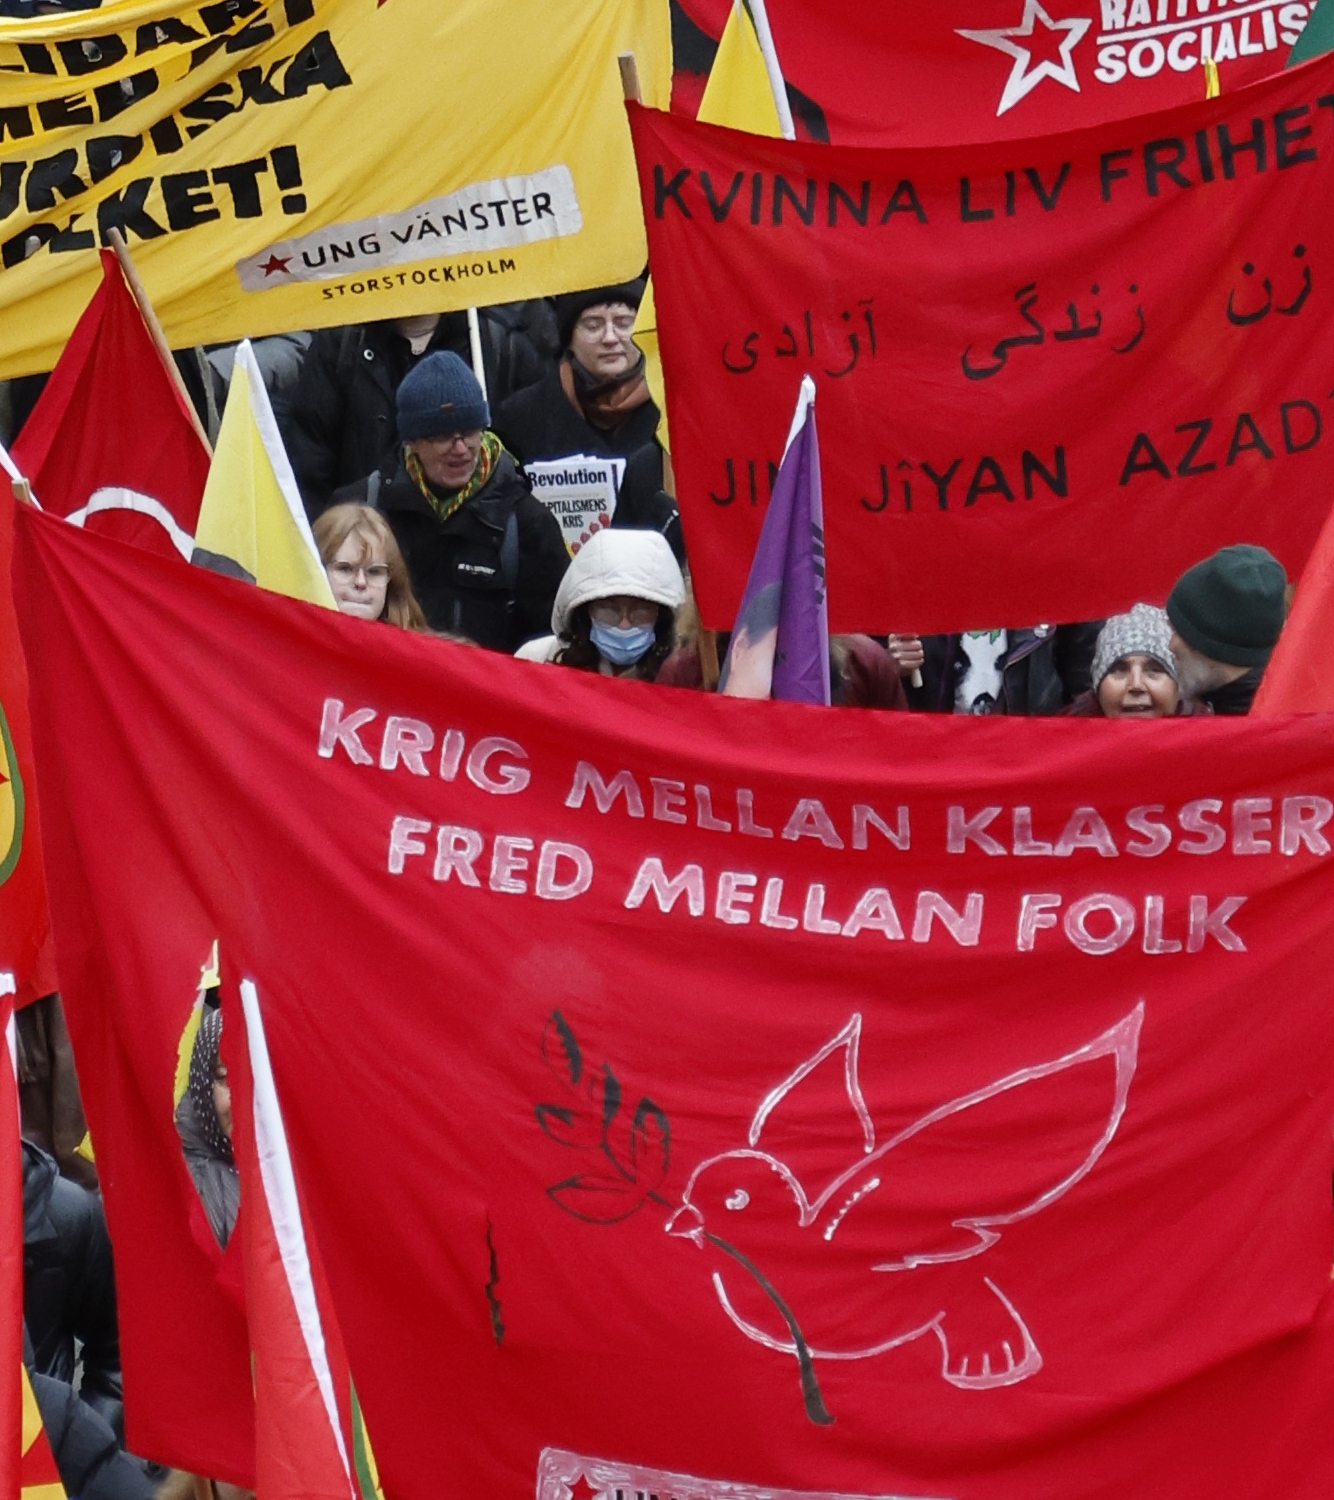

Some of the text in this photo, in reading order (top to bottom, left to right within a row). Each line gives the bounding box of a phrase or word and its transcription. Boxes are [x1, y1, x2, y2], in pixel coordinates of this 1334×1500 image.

[1094, 0, 1317, 85] SOCIALIS
[654, 163, 930, 228] KVINNA
[959, 162, 1072, 224] LIV
[301, 191, 556, 269] UNG VÄNSTER
[321, 258, 517, 300] STORSTOCKHOLM
[528, 468, 608, 488] Revolution
[547, 498, 608, 514] PITALISMENS
[562, 514, 584, 529] KRIS
[317, 697, 532, 796] KRIG
[565, 760, 913, 852] MELLAN
[387, 815, 1250, 956] FRED MELLAN FOLK
